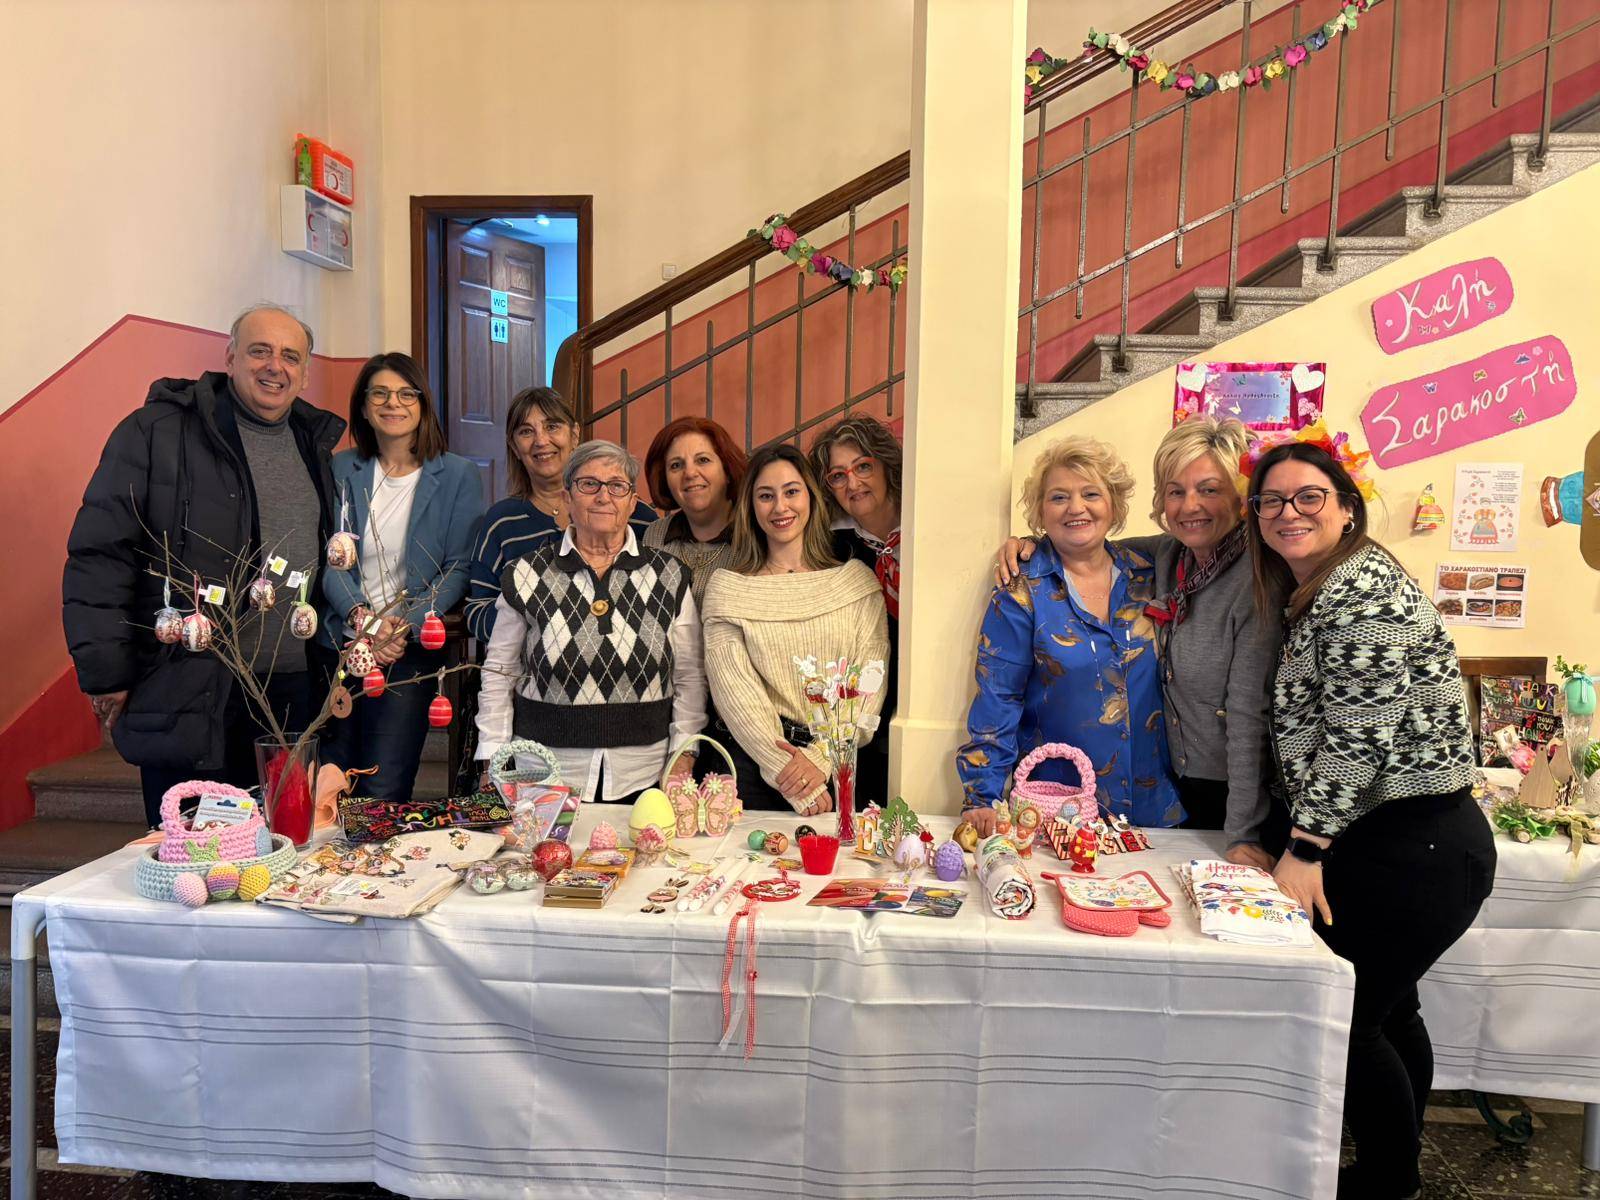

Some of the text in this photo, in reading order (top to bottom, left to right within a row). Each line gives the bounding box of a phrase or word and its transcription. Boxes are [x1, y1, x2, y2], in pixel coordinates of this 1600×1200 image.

[494, 298, 506, 307] WC
[1391, 268, 1496, 344] Καλή
[1371, 351, 1567, 458] Σαρακοστή
